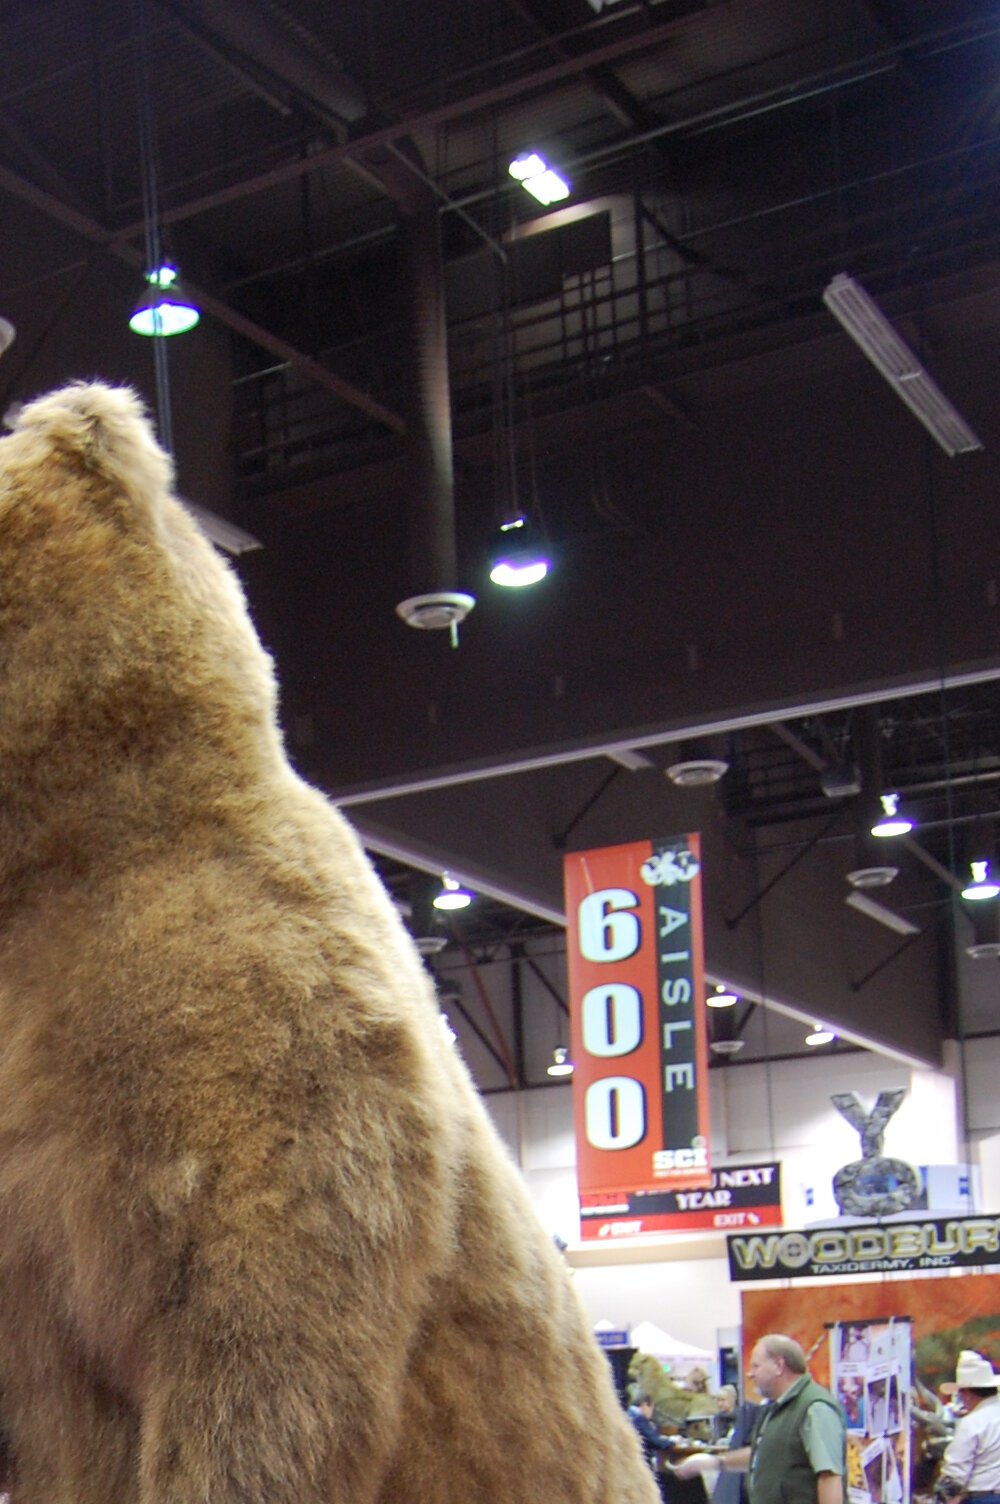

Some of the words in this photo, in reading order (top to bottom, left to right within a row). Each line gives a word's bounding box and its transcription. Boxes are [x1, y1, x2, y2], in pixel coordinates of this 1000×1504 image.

[659, 906, 695, 1091] AISLE
[578, 888, 646, 1150] 600
[653, 1149, 706, 1169] SCI
[720, 1168, 774, 1187] NEXT
[675, 1190, 732, 1210] YEAR
[731, 1219, 1000, 1269] WOODBUR
[919, 1255, 955, 1267] INC.
